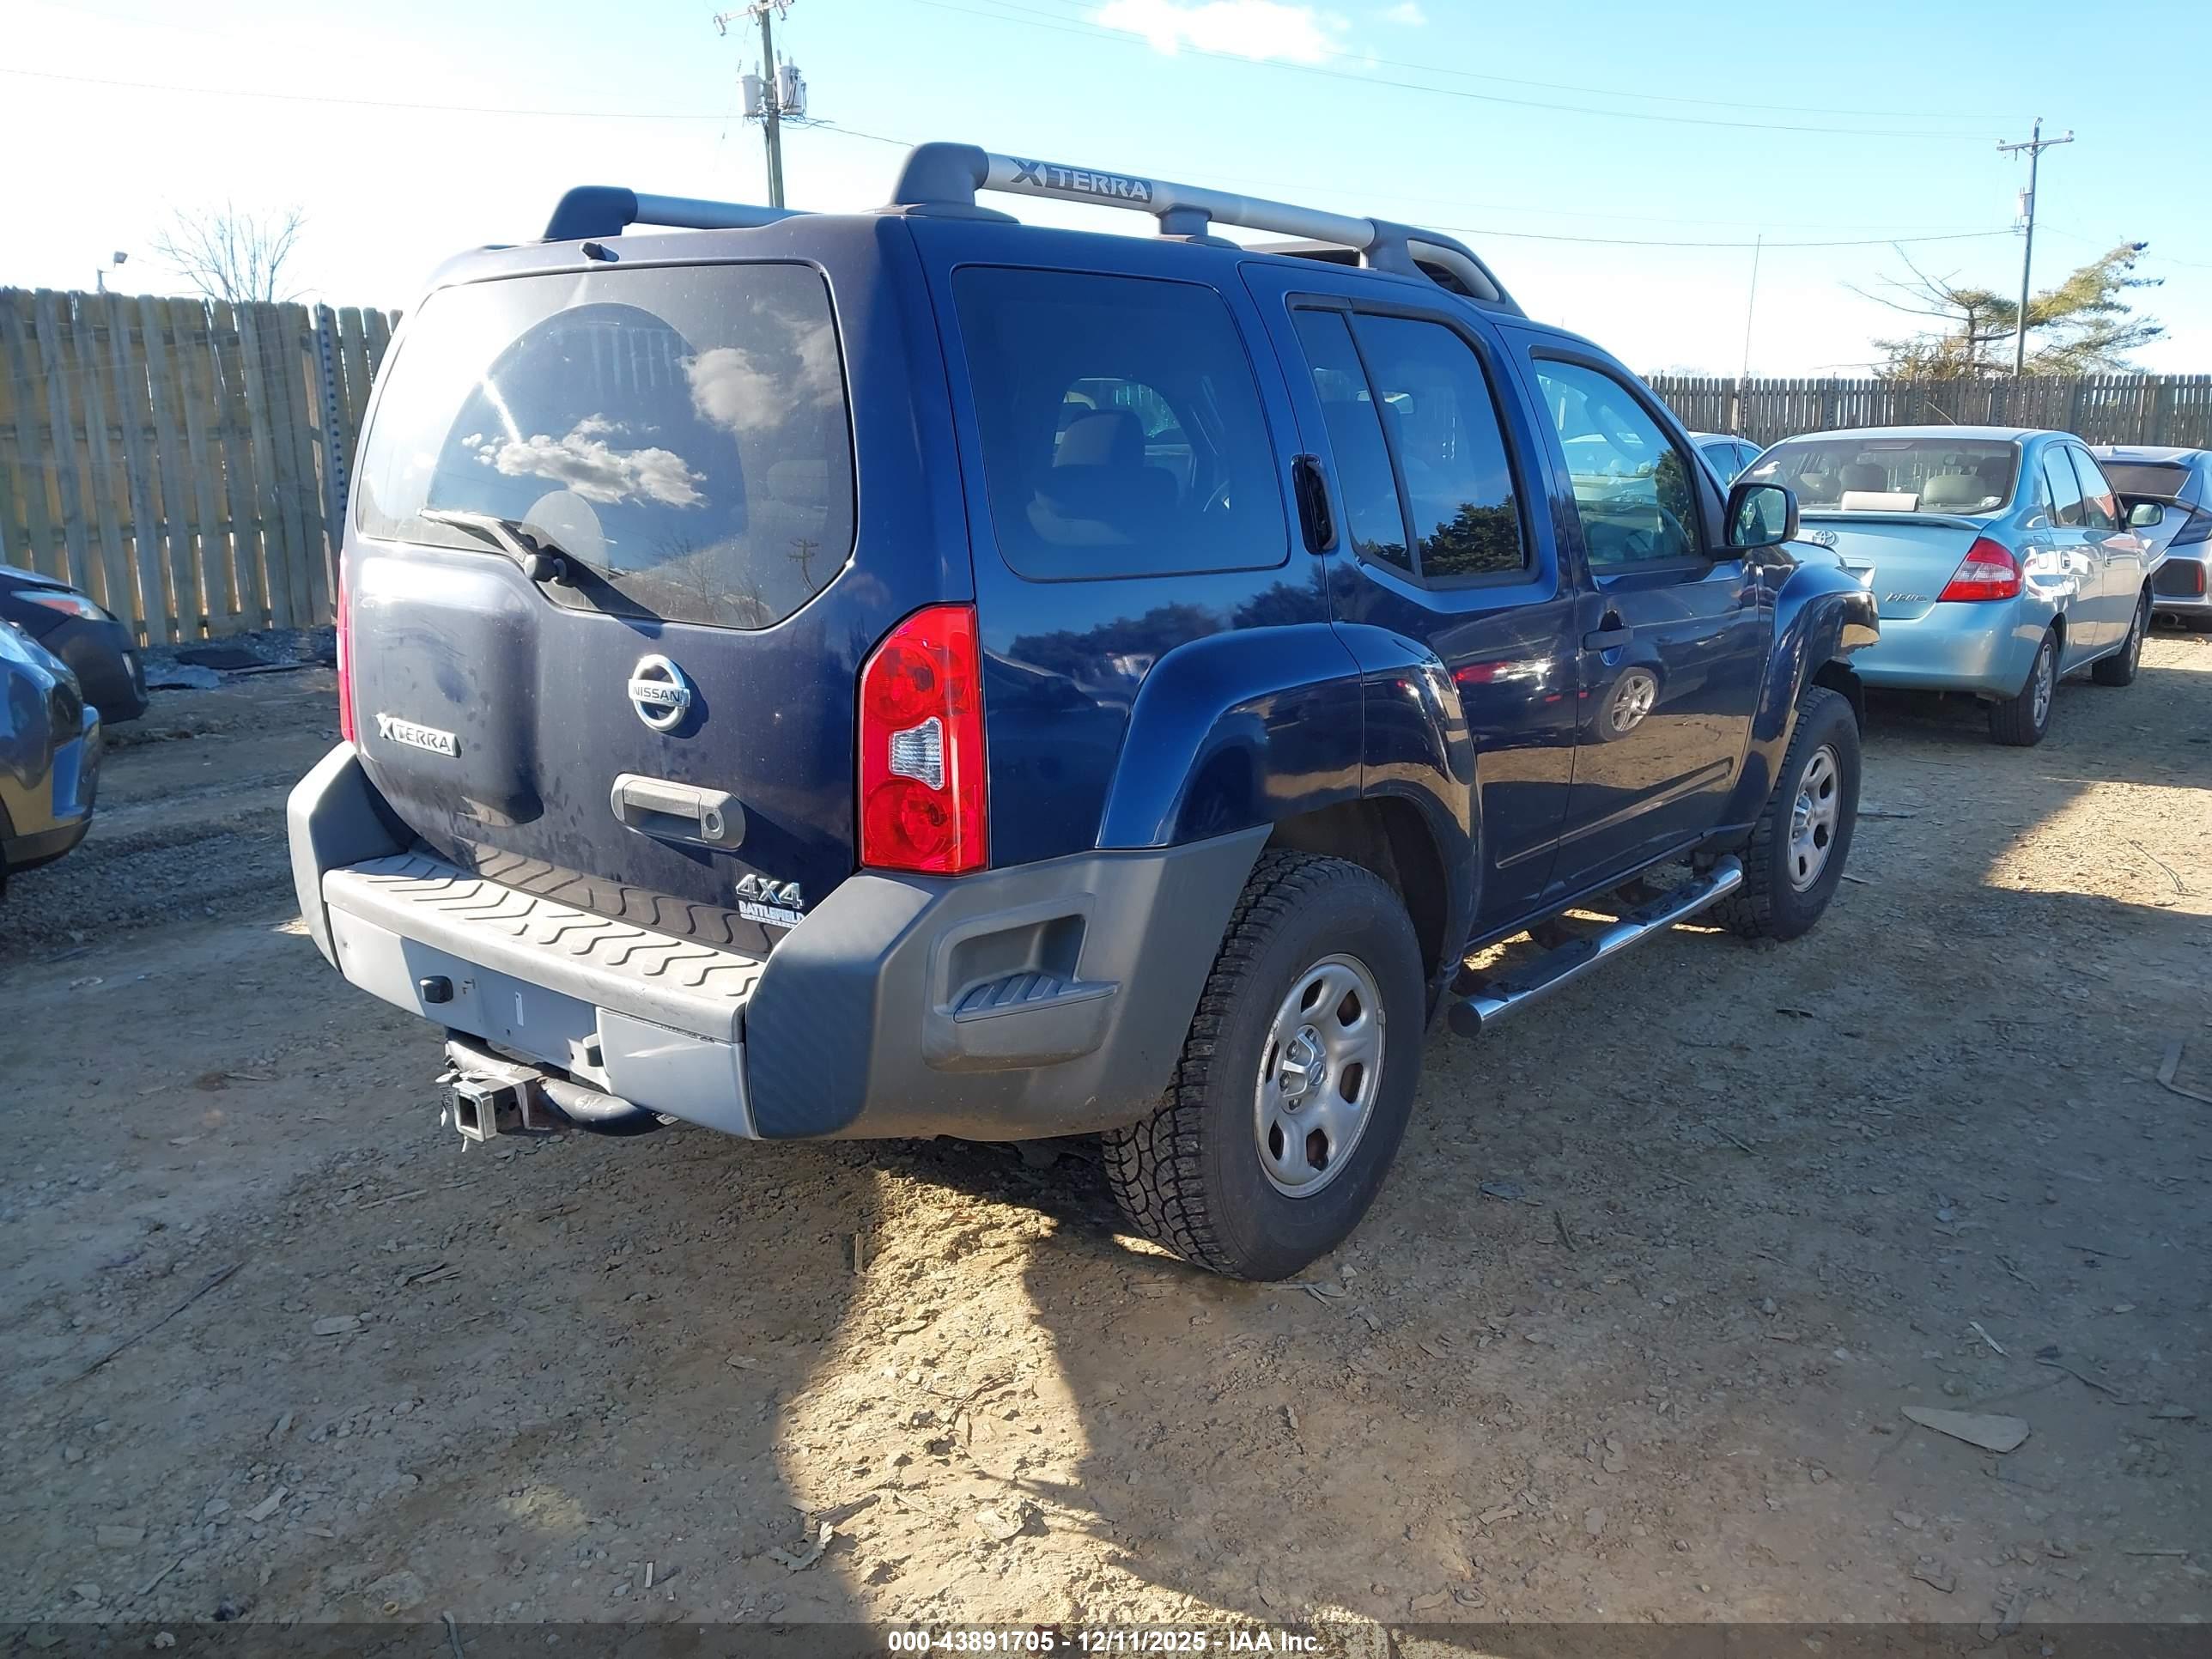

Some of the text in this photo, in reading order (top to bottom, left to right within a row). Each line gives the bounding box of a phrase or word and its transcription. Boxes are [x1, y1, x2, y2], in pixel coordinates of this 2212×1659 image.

[1009, 157, 1149, 201] XTERRA
[633, 686, 680, 702] NISSAN
[373, 714, 453, 752] XTERRA
